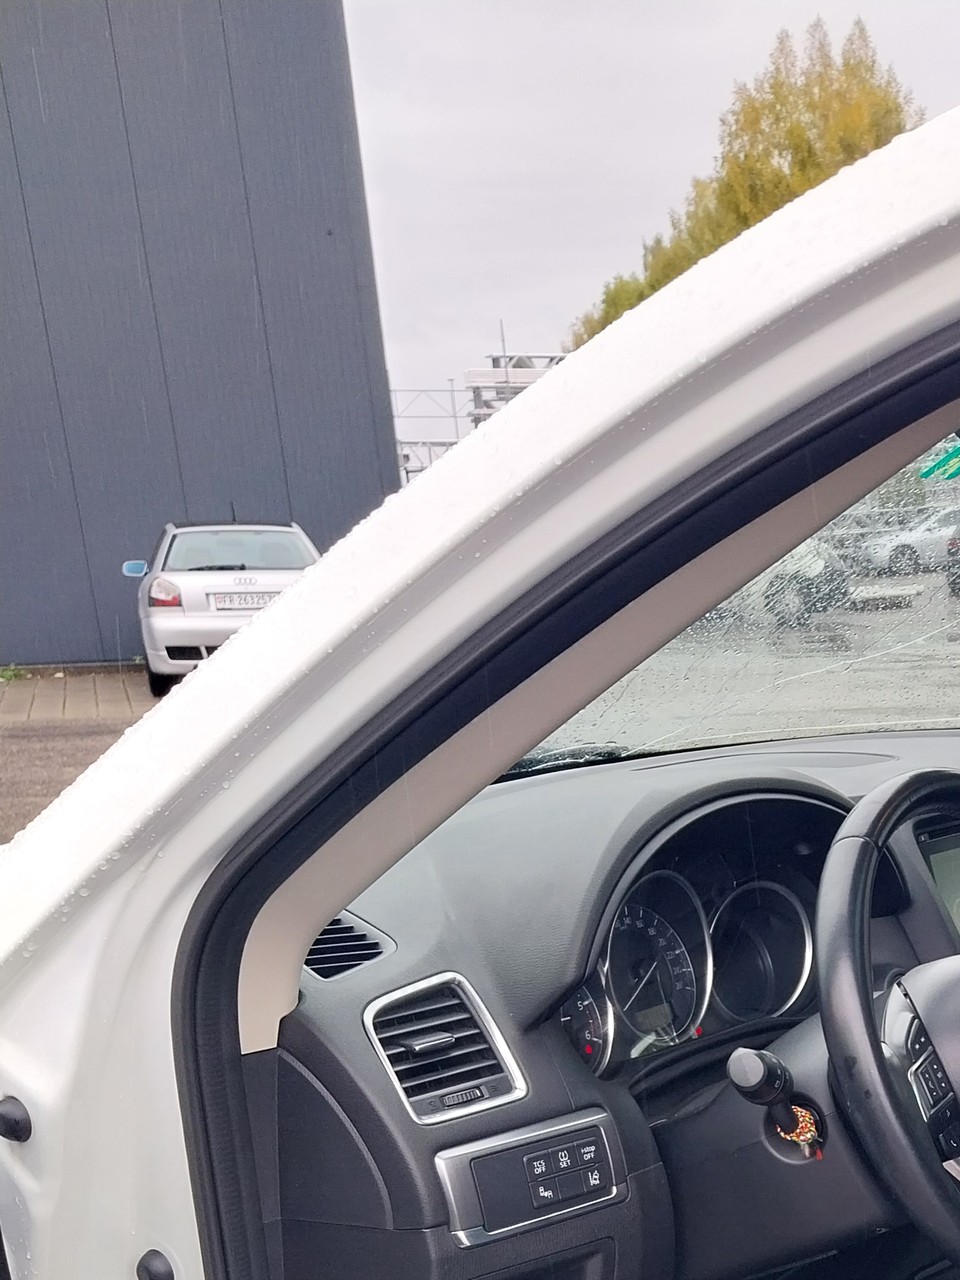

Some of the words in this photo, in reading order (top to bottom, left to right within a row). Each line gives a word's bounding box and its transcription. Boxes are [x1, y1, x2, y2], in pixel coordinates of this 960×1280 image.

[577, 1000, 583, 1011] 5
[584, 1030, 591, 1040] 6
[583, 1152, 595, 1161] OFF
[533, 1160, 545, 1168] TCS
[559, 1160, 571, 1169] SET
[534, 1166, 546, 1175] OFF
